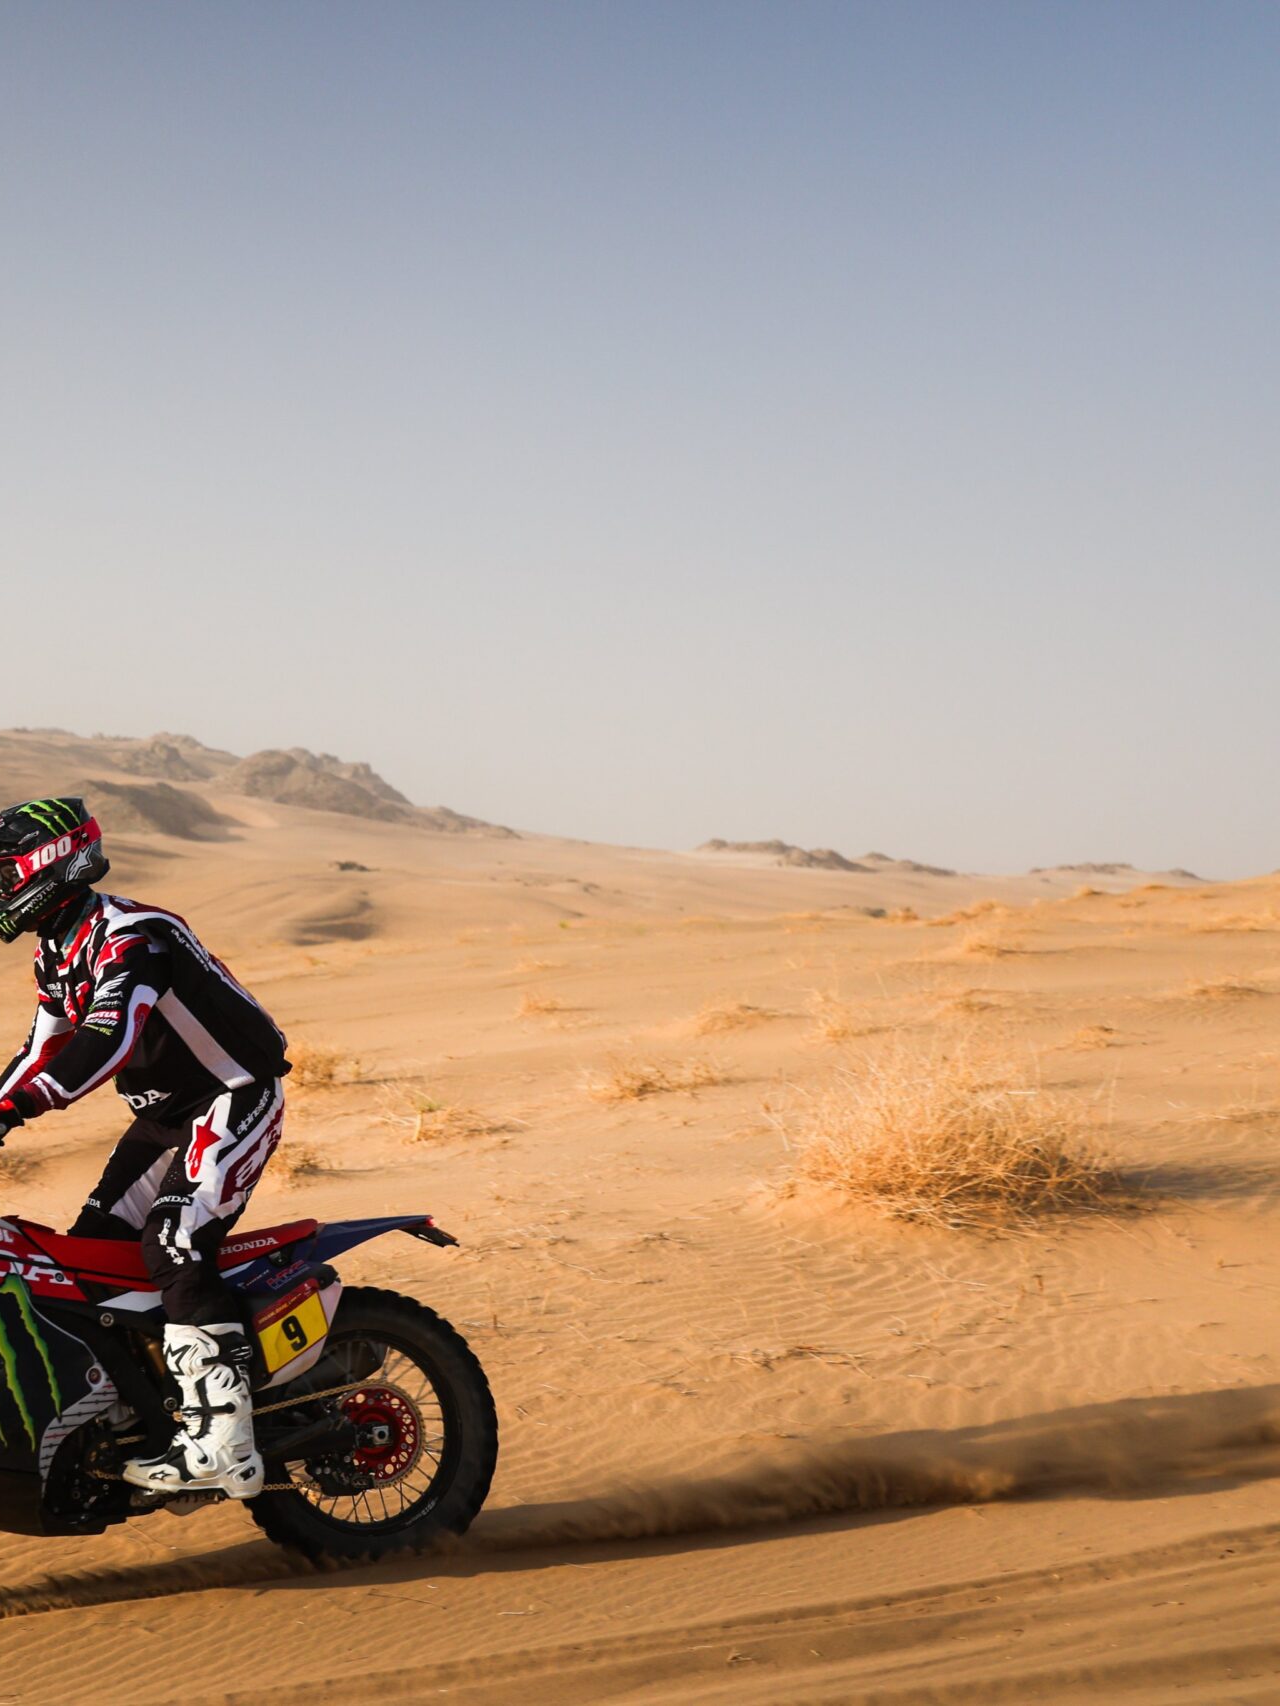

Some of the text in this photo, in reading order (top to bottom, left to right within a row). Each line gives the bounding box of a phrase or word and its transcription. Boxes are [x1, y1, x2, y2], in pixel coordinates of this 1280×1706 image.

[28, 828, 88, 871] 100%
[21, 881, 58, 914] MONSTER
[219, 1237, 280, 1255] HONDA
[281, 1315, 308, 1352] 9
